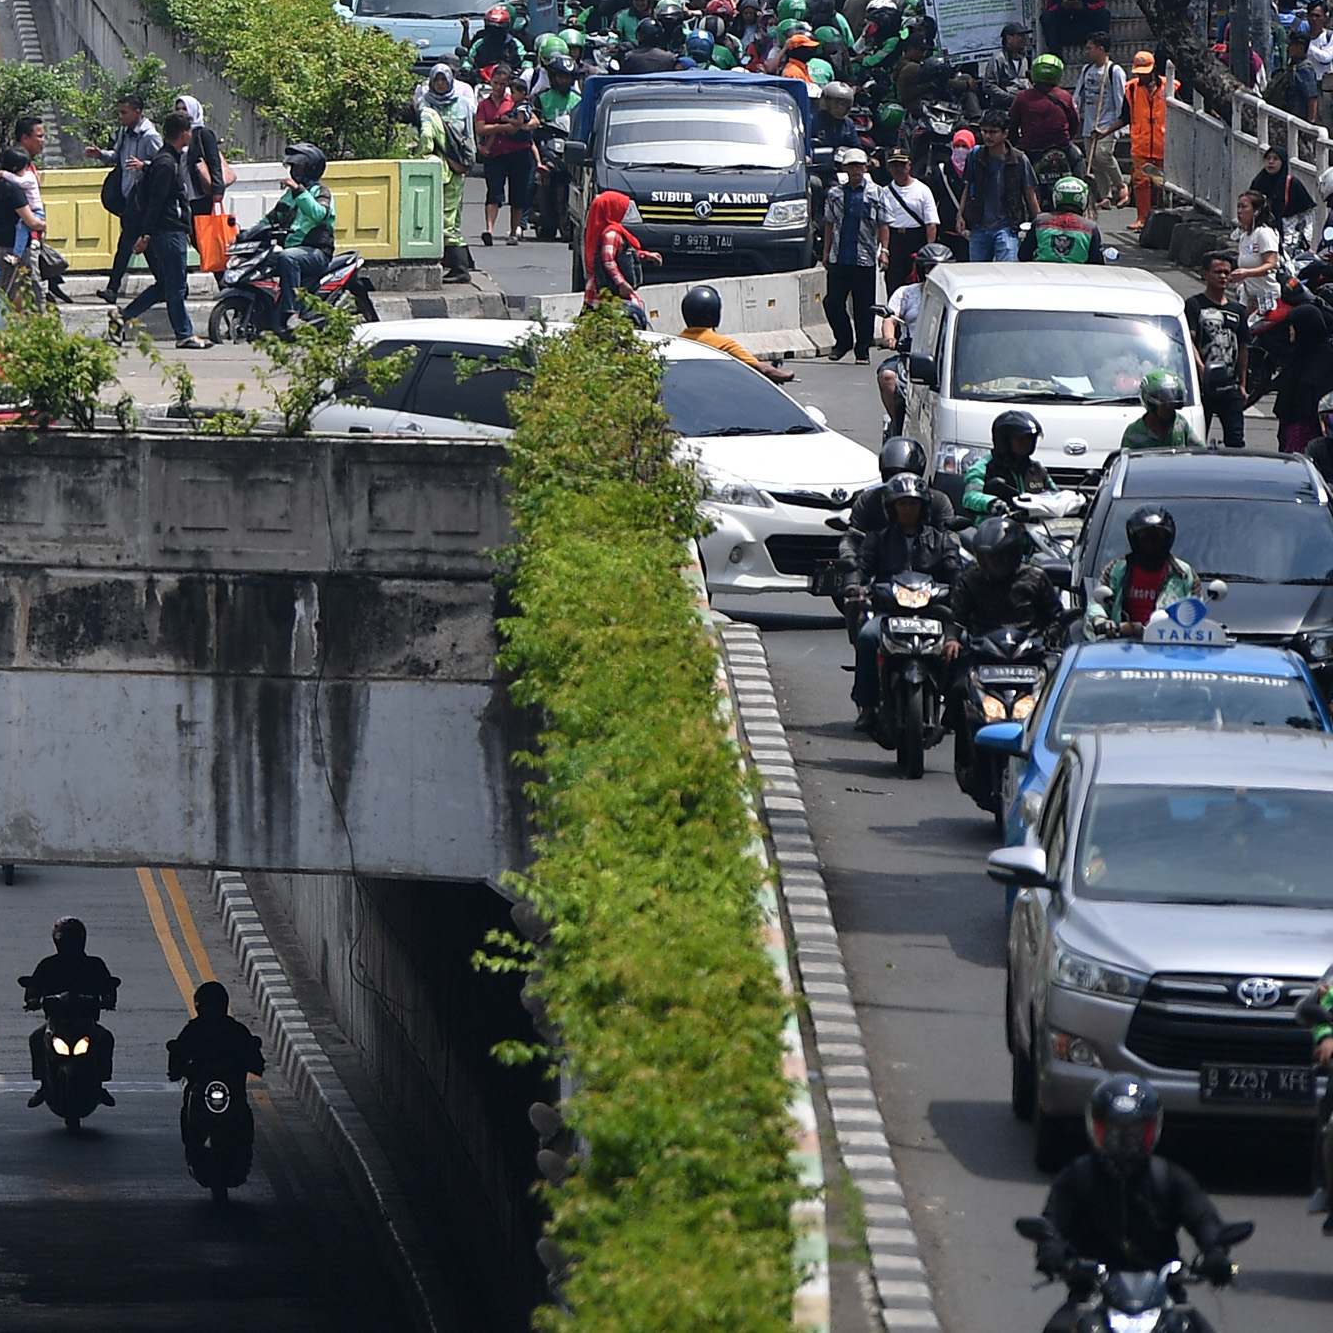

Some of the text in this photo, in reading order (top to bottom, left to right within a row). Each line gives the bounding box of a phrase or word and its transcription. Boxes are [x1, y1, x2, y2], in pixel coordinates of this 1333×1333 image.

[651, 191, 769, 204] SUBUR MAKMUR
[674, 235, 733, 247] B 9978 TAU
[1157, 629, 1214, 641] TAKSI
[1120, 670, 1290, 687] BLUE BIRD GROUP
